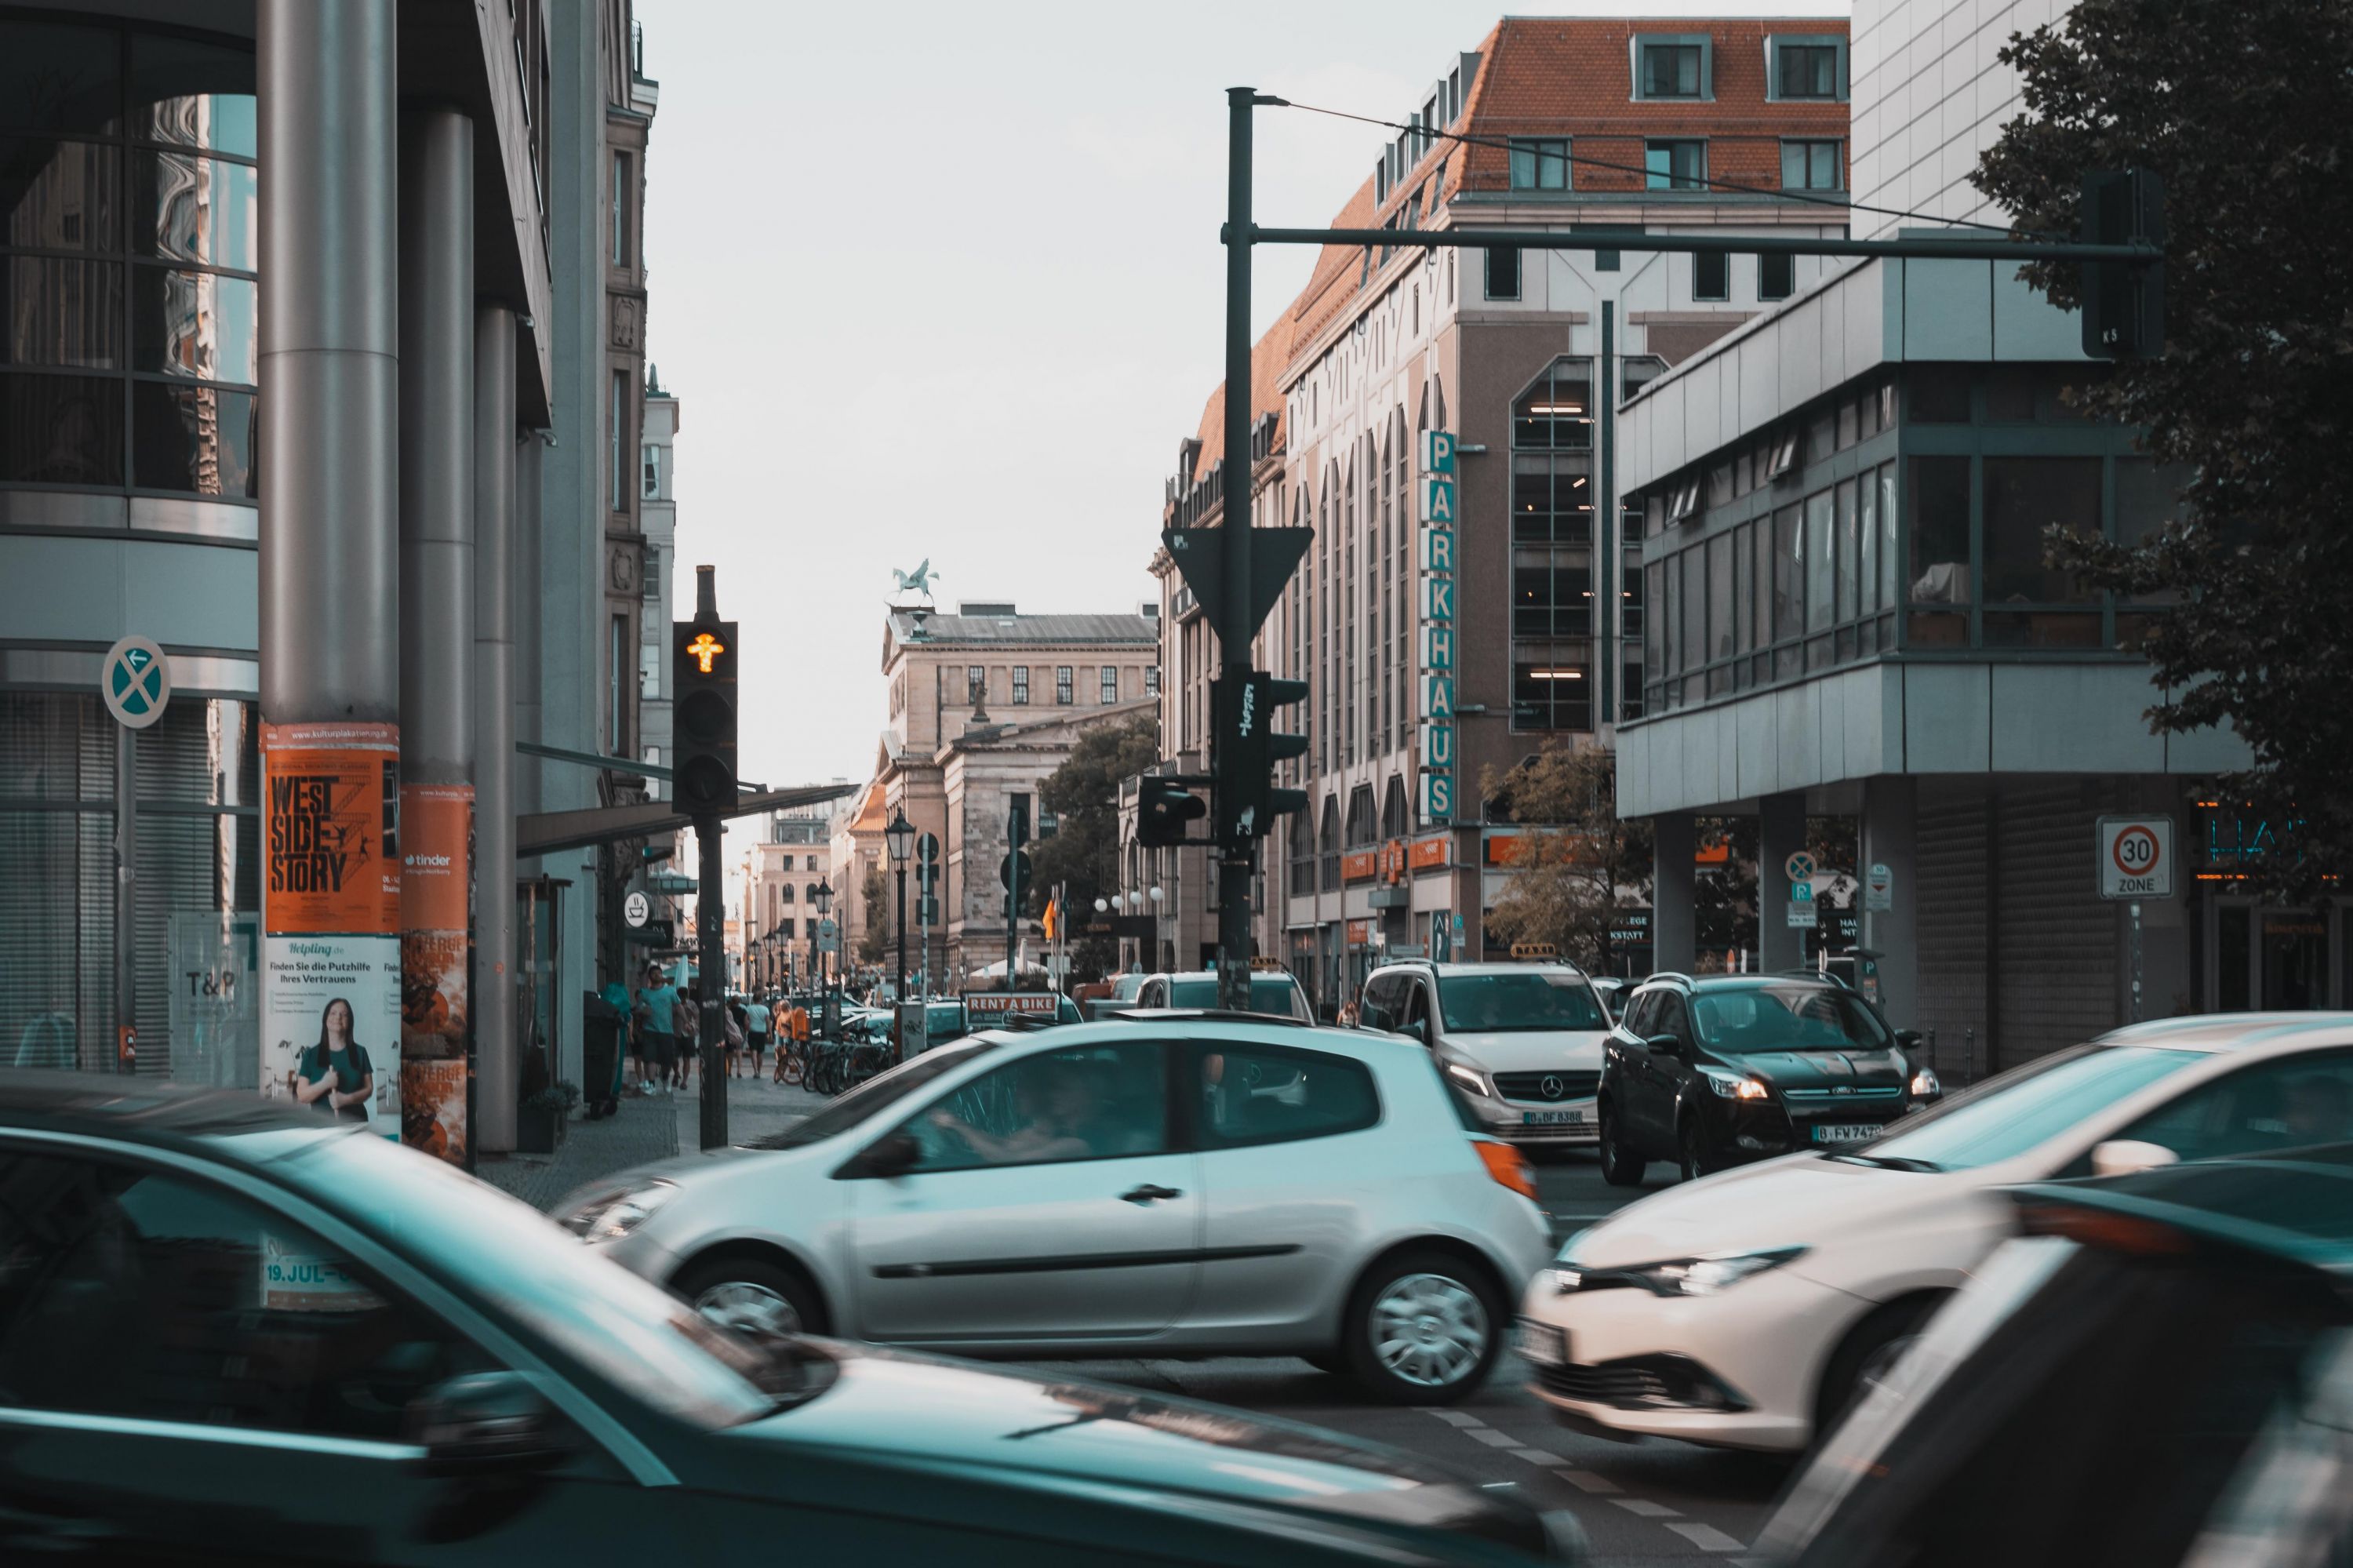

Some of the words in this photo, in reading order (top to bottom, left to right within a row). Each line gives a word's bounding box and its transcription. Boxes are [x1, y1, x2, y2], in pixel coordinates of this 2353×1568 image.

[1431, 435, 1450, 813] PARKHAUS
[291, 728, 387, 740] www.kulturplakatierung.de
[271, 776, 339, 814] WEST
[271, 814, 332, 852] SIDE
[2123, 839, 2150, 863] 30
[415, 853, 451, 866] tinder
[271, 853, 347, 893] STORY
[2118, 878, 2155, 893] ZONE
[289, 943, 345, 957] Helpling.de
[1519, 945, 1550, 955] TAXI
[270, 962, 294, 971] Finden
[296, 962, 309, 971] Sie
[311, 962, 326, 971] die
[329, 962, 371, 972] Putzhilfe
[1866, 962, 1875, 974] P
[186, 971, 235, 997] T&P
[281, 975, 300, 984] Ihres
[303, 975, 356, 984] Vertrauens
[971, 999, 1006, 1010] RENT
[1009, 999, 1019, 1010] A
[1022, 999, 1053, 1010] BIKE
[1835, 1127, 1849, 1139] FW
